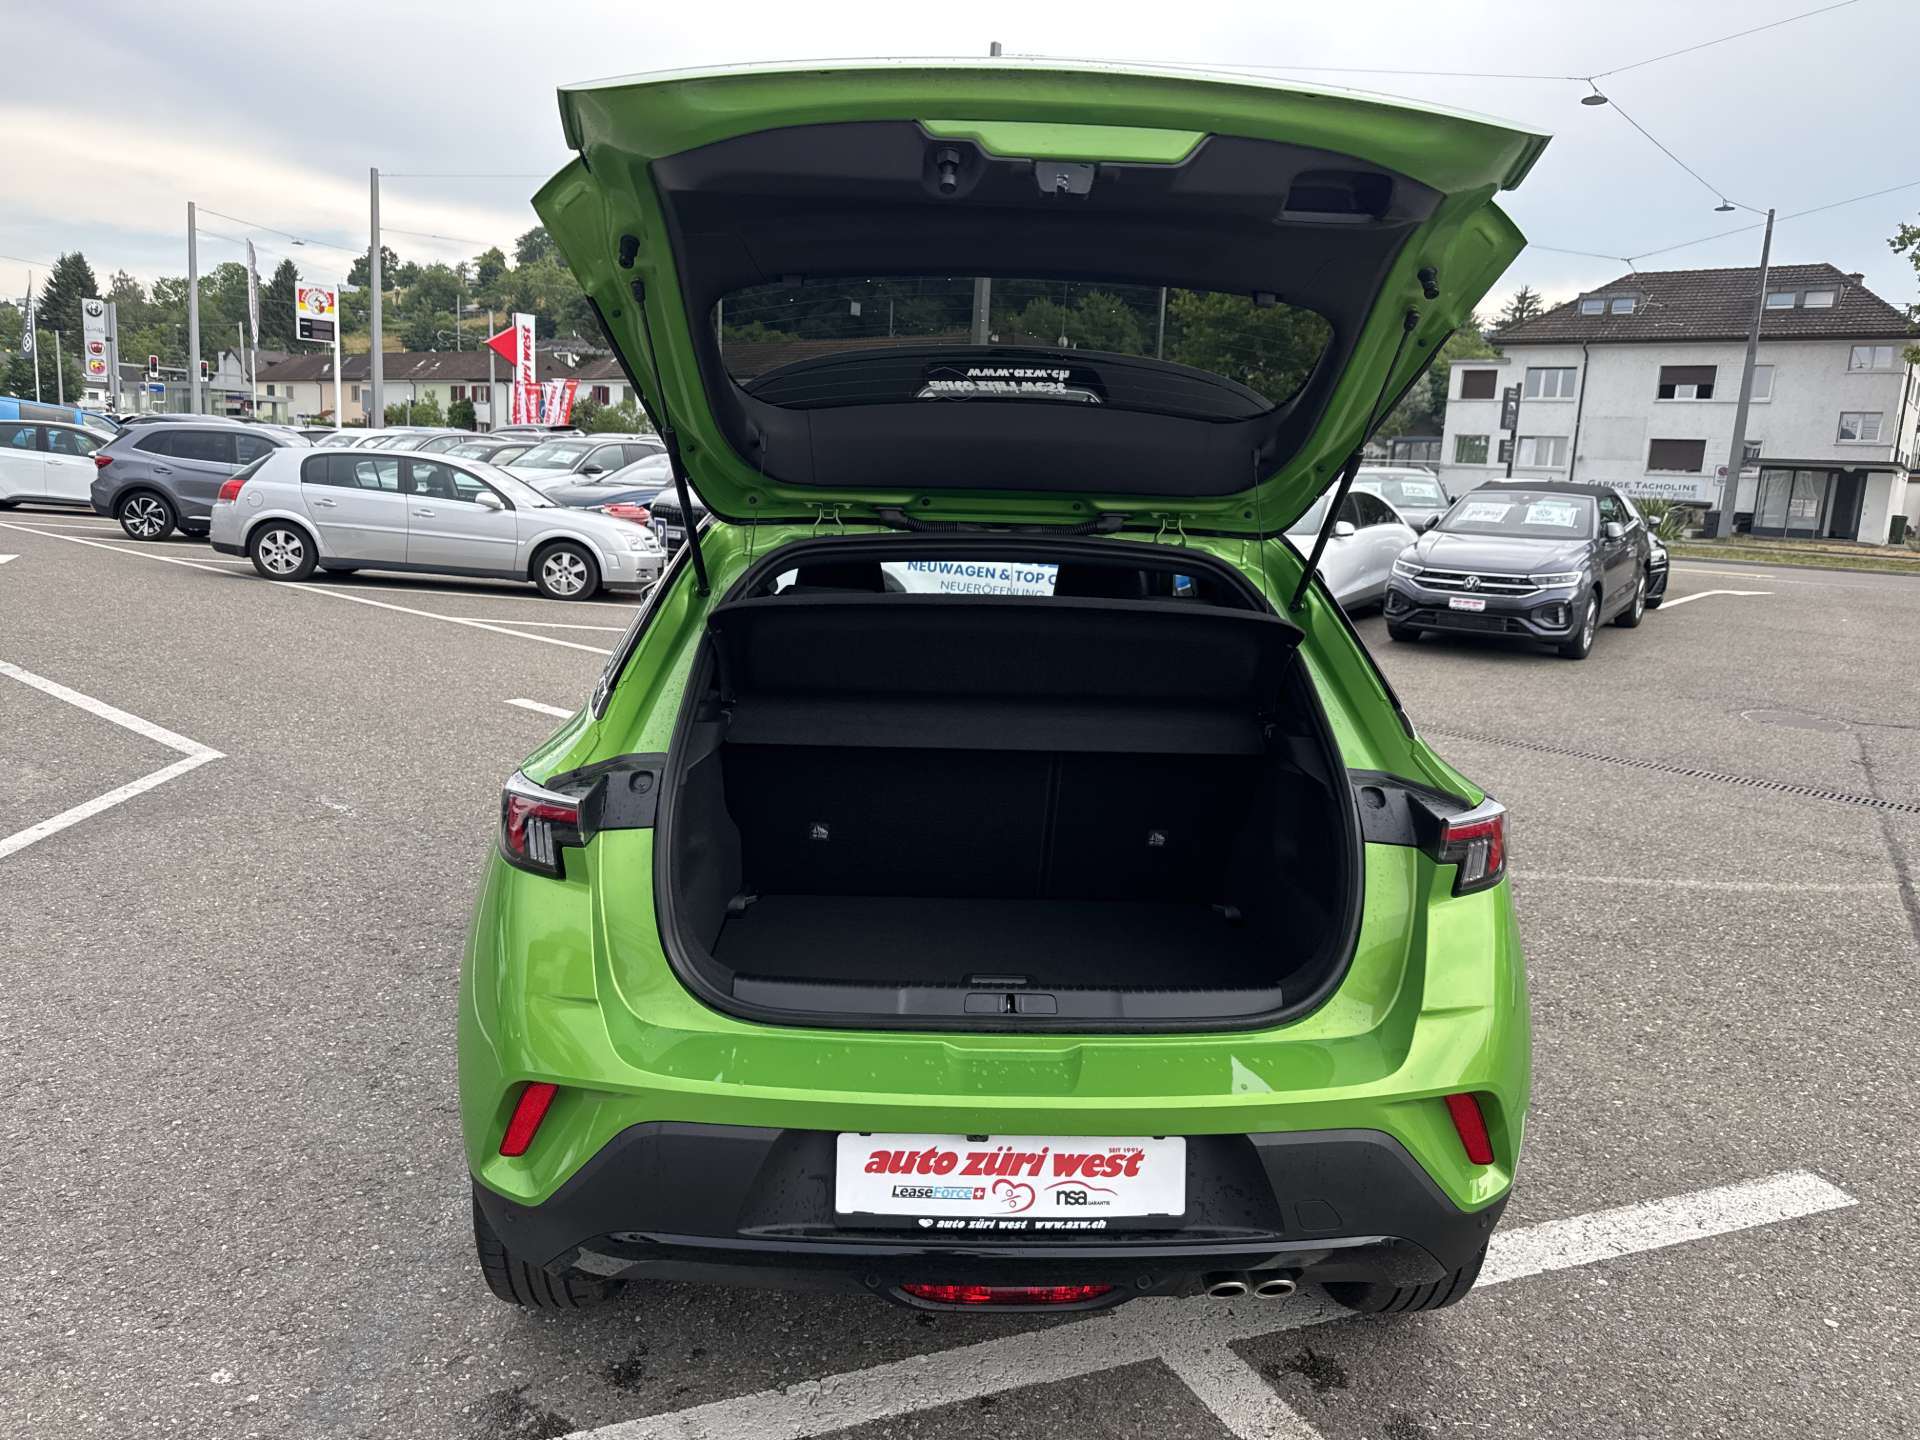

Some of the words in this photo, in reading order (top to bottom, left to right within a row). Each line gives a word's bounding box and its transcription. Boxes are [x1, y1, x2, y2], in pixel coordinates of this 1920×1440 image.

[1588, 480, 1630, 489] GARAGE
[1635, 481, 1698, 491] TACHOLINE
[907, 561, 996, 579] NEUWAGEN
[1000, 568, 1011, 581] &
[1015, 570, 1045, 584] TOP
[864, 1145, 958, 1175] auto
[959, 1145, 1051, 1177] züri
[1052, 1148, 1145, 1177] west
[892, 1185, 972, 1199] LeaseForce
[1056, 1190, 1087, 1206] nsa
[936, 1218, 966, 1229] auto
[967, 1217, 996, 1229] züri
[998, 1219, 1027, 1229] west
[1035, 1219, 1107, 1229] www.azw.ch
